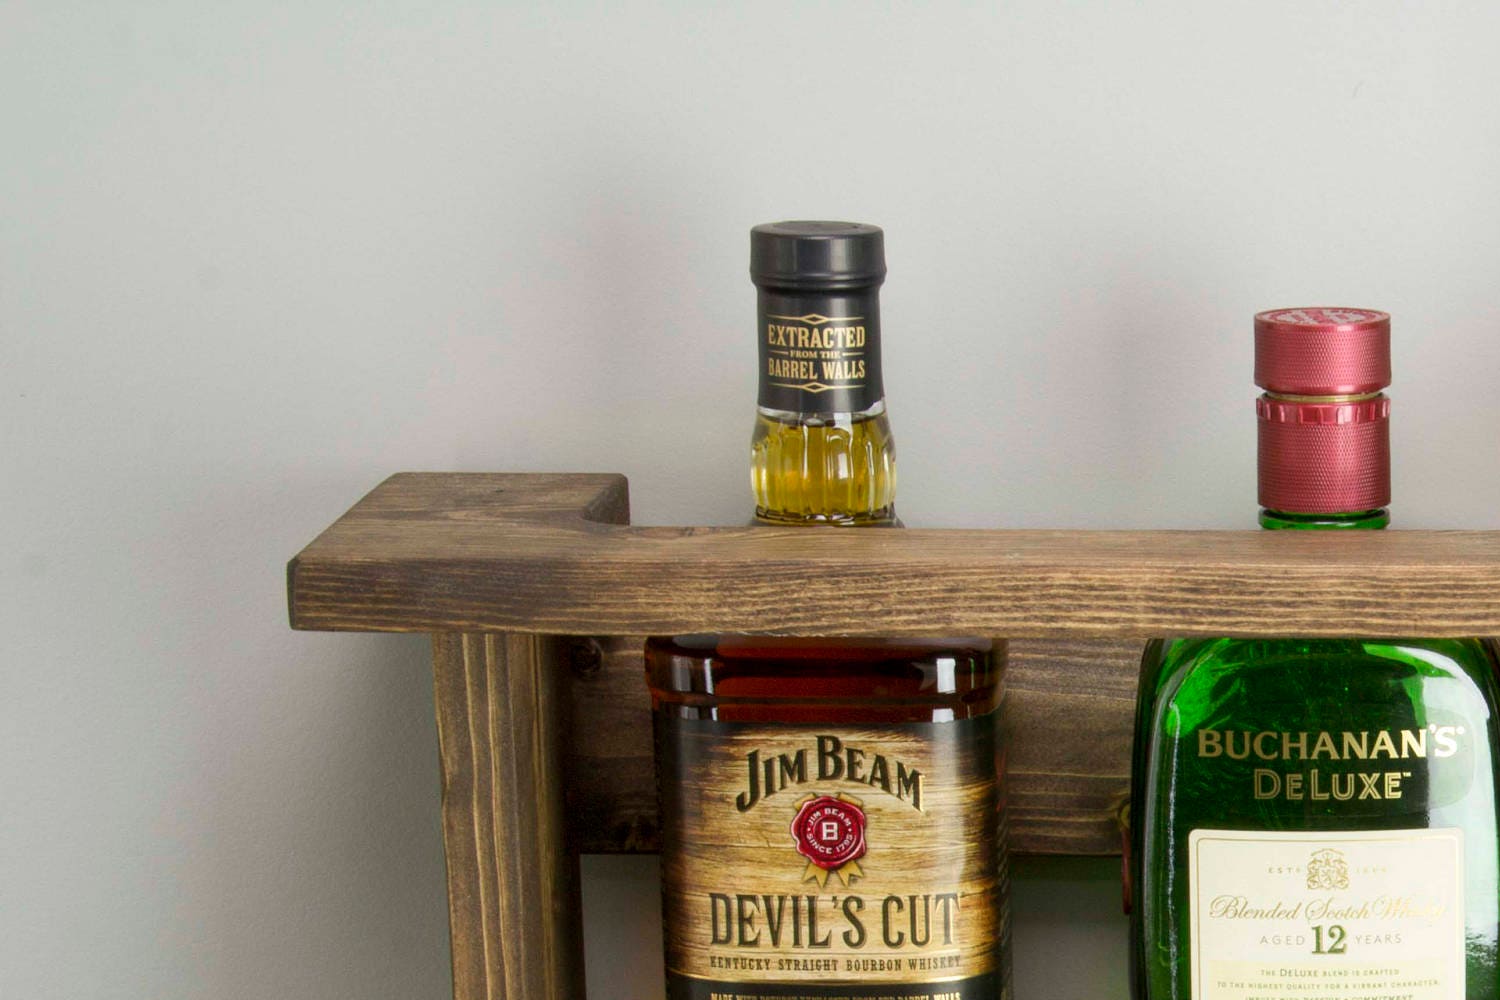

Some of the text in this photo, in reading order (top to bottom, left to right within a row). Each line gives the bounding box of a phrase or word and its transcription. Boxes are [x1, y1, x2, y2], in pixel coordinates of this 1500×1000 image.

[768, 324, 865, 349] EXTRACTED
[790, 350, 842, 359] FROM THE
[768, 358, 865, 380] BARREL WALLS
[1198, 723, 1459, 761] BUCHANAN'S
[736, 735, 926, 813] JIM BEAM
[808, 807, 852, 827] JIM BEAM
[822, 822, 838, 841] B
[806, 833, 833, 855] SINCE
[1209, 895, 1302, 920] Blended
[1304, 896, 1370, 921] Scotch
[709, 892, 961, 949] DEVIL'S CUT
[1259, 924, 1402, 955] AGED 12 YEARS
[710, 955, 961, 971] KENTUCKY STRAIGHT BOURBON WHISKEY
[1280, 968, 1318, 977] DELUXE
